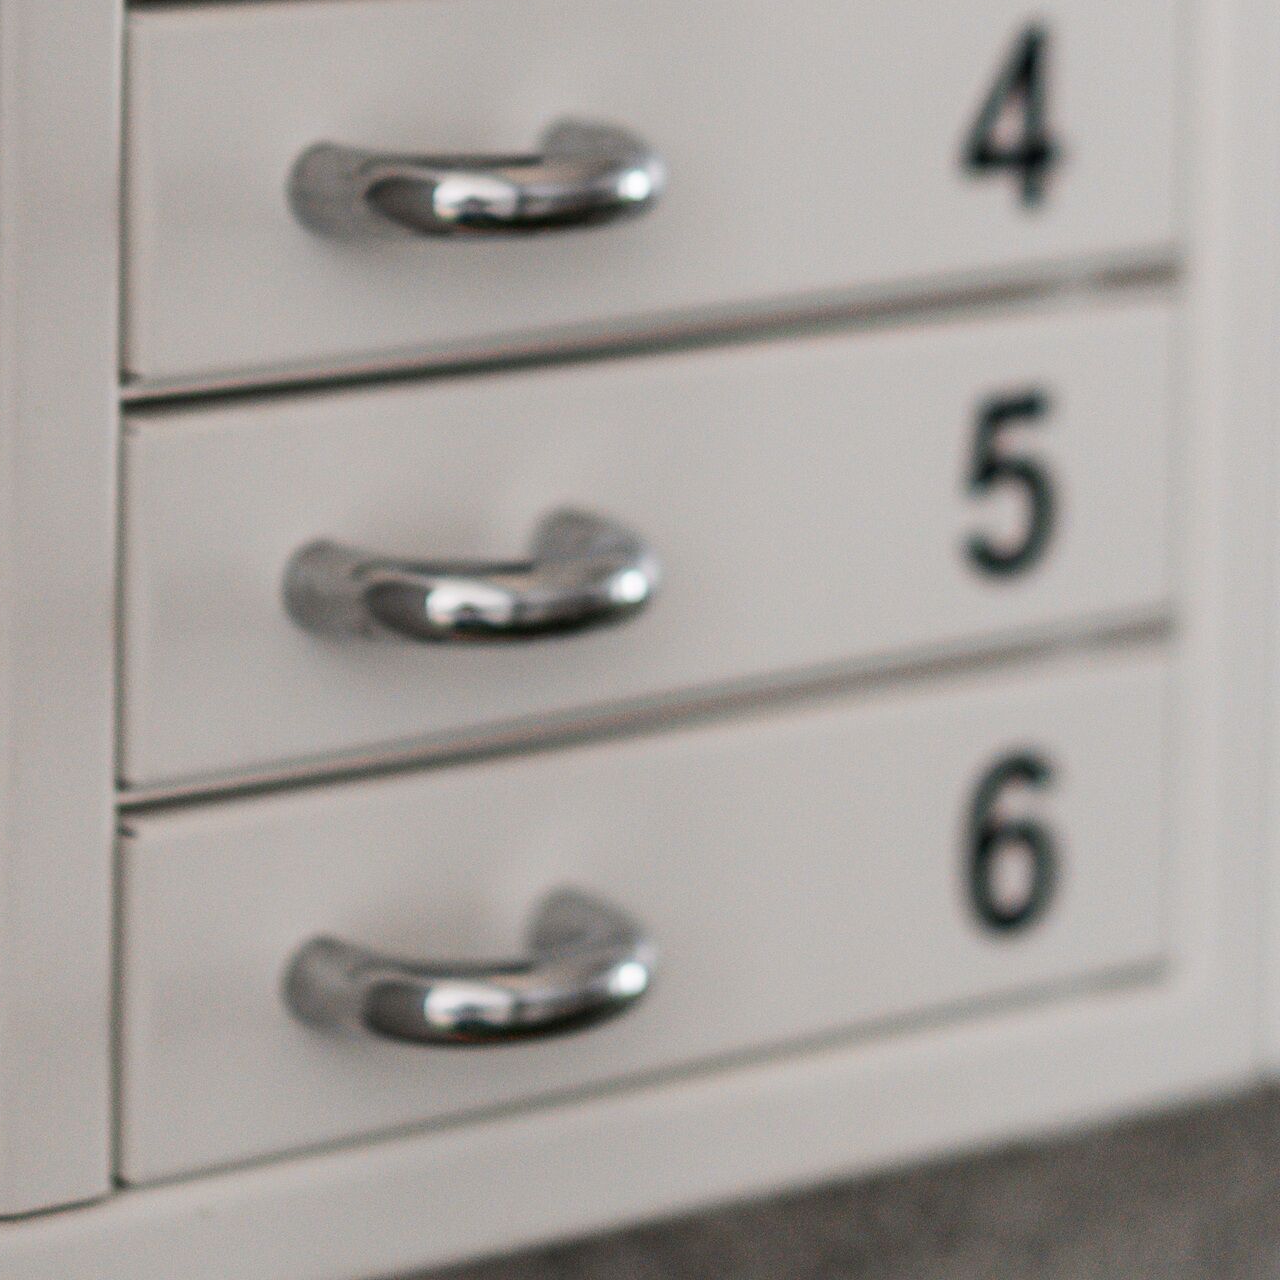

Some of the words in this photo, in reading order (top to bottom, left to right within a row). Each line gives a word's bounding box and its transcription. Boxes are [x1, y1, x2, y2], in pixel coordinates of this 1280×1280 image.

[958, 23, 1064, 209] 4
[961, 385, 1062, 586] 5
[958, 747, 1063, 943] 6
